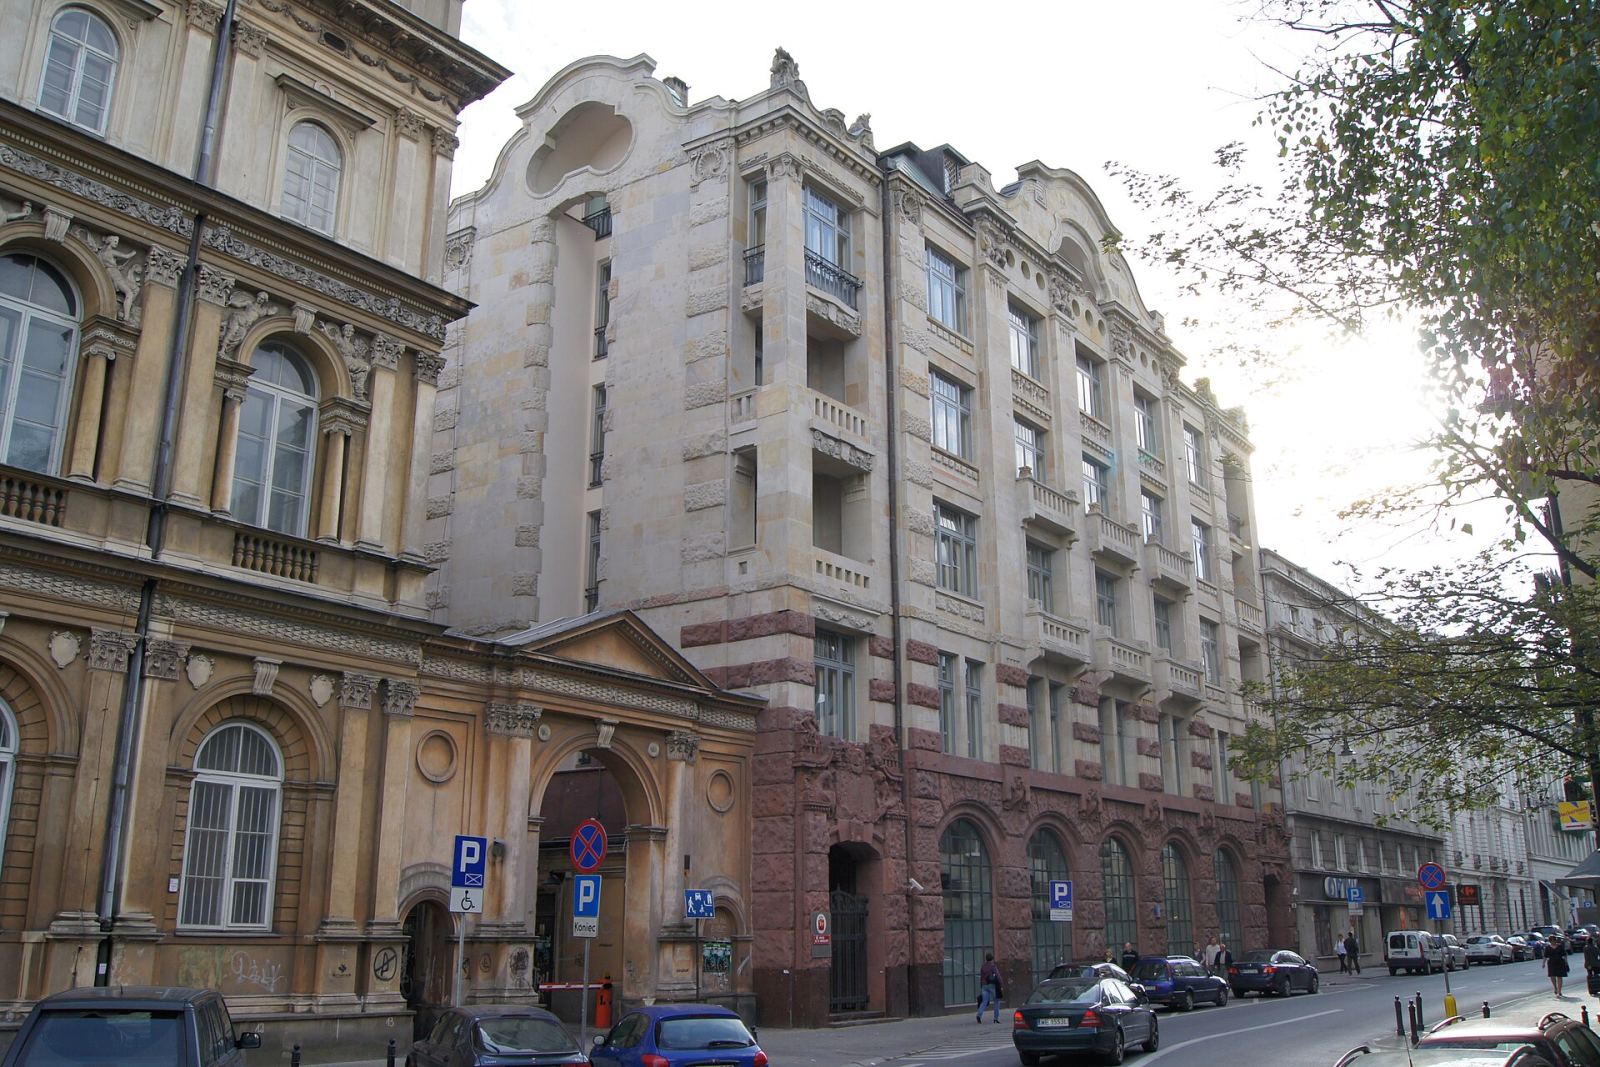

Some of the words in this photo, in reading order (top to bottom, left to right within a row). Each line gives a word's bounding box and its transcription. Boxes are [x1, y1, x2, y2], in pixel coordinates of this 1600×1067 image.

[460, 840, 480, 873] P
[579, 879, 595, 912] P
[1055, 883, 1068, 901] P
[1350, 888, 1360, 901] P
[574, 921, 596, 933] Koniec
